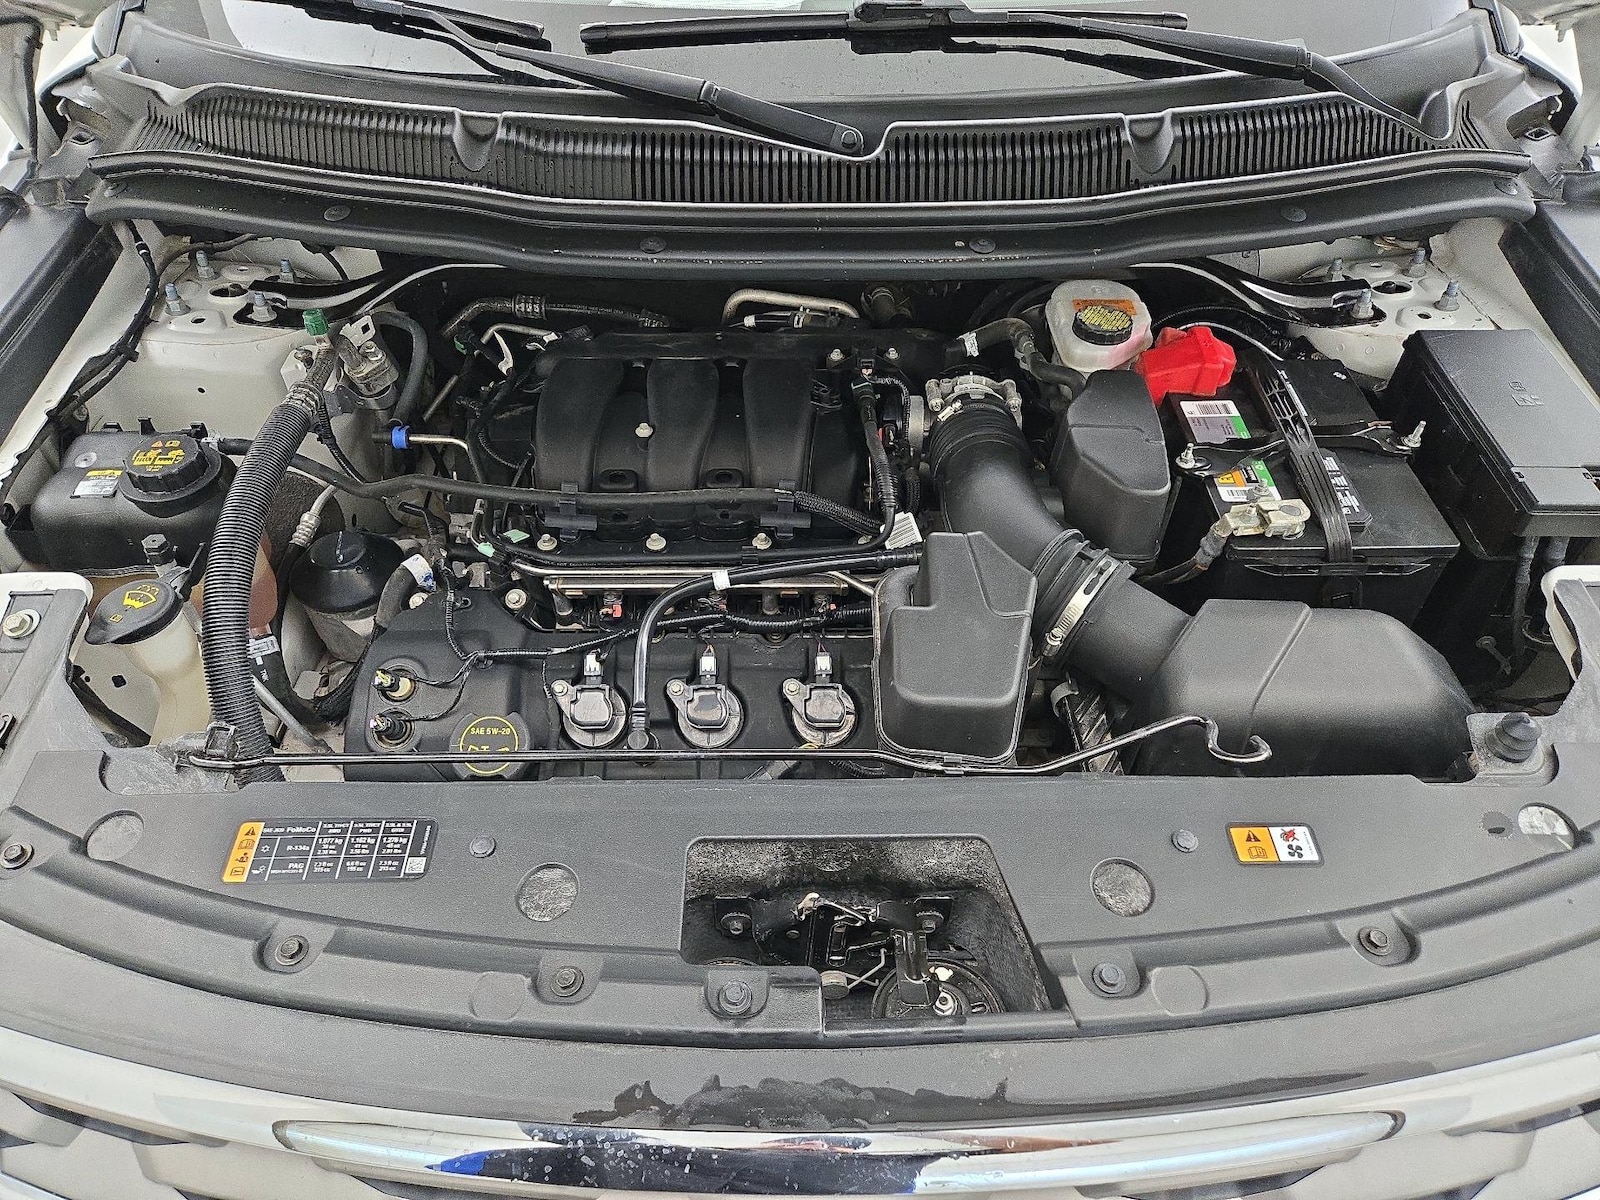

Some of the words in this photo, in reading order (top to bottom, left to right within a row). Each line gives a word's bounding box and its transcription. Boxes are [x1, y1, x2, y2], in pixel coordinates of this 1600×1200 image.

[470, 727, 485, 735] SAE
[486, 727, 511, 735] 5W-20
[400, 836, 409, 844] kg
